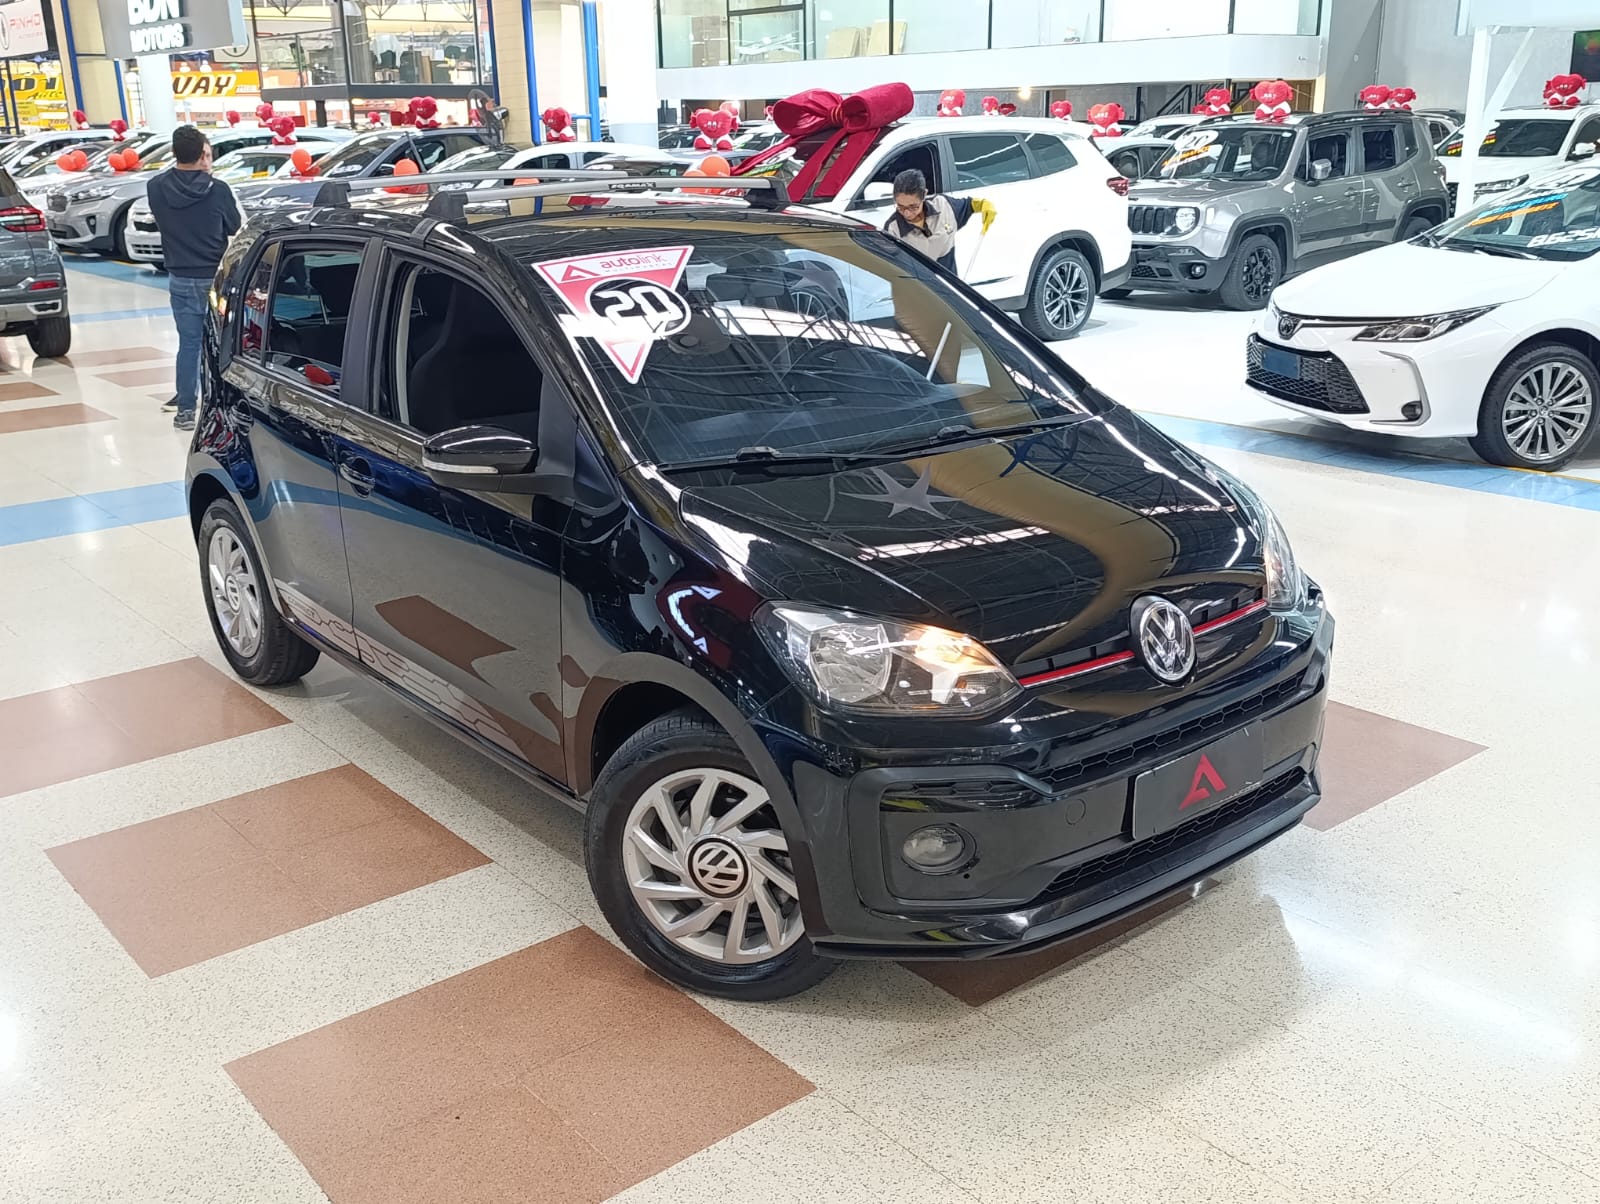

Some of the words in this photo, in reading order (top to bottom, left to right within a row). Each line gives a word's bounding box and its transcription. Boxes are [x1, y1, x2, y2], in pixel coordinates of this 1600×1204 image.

[130, 23, 185, 52] MOTORS
[600, 253, 663, 269] autolink
[594, 285, 684, 329] 20
